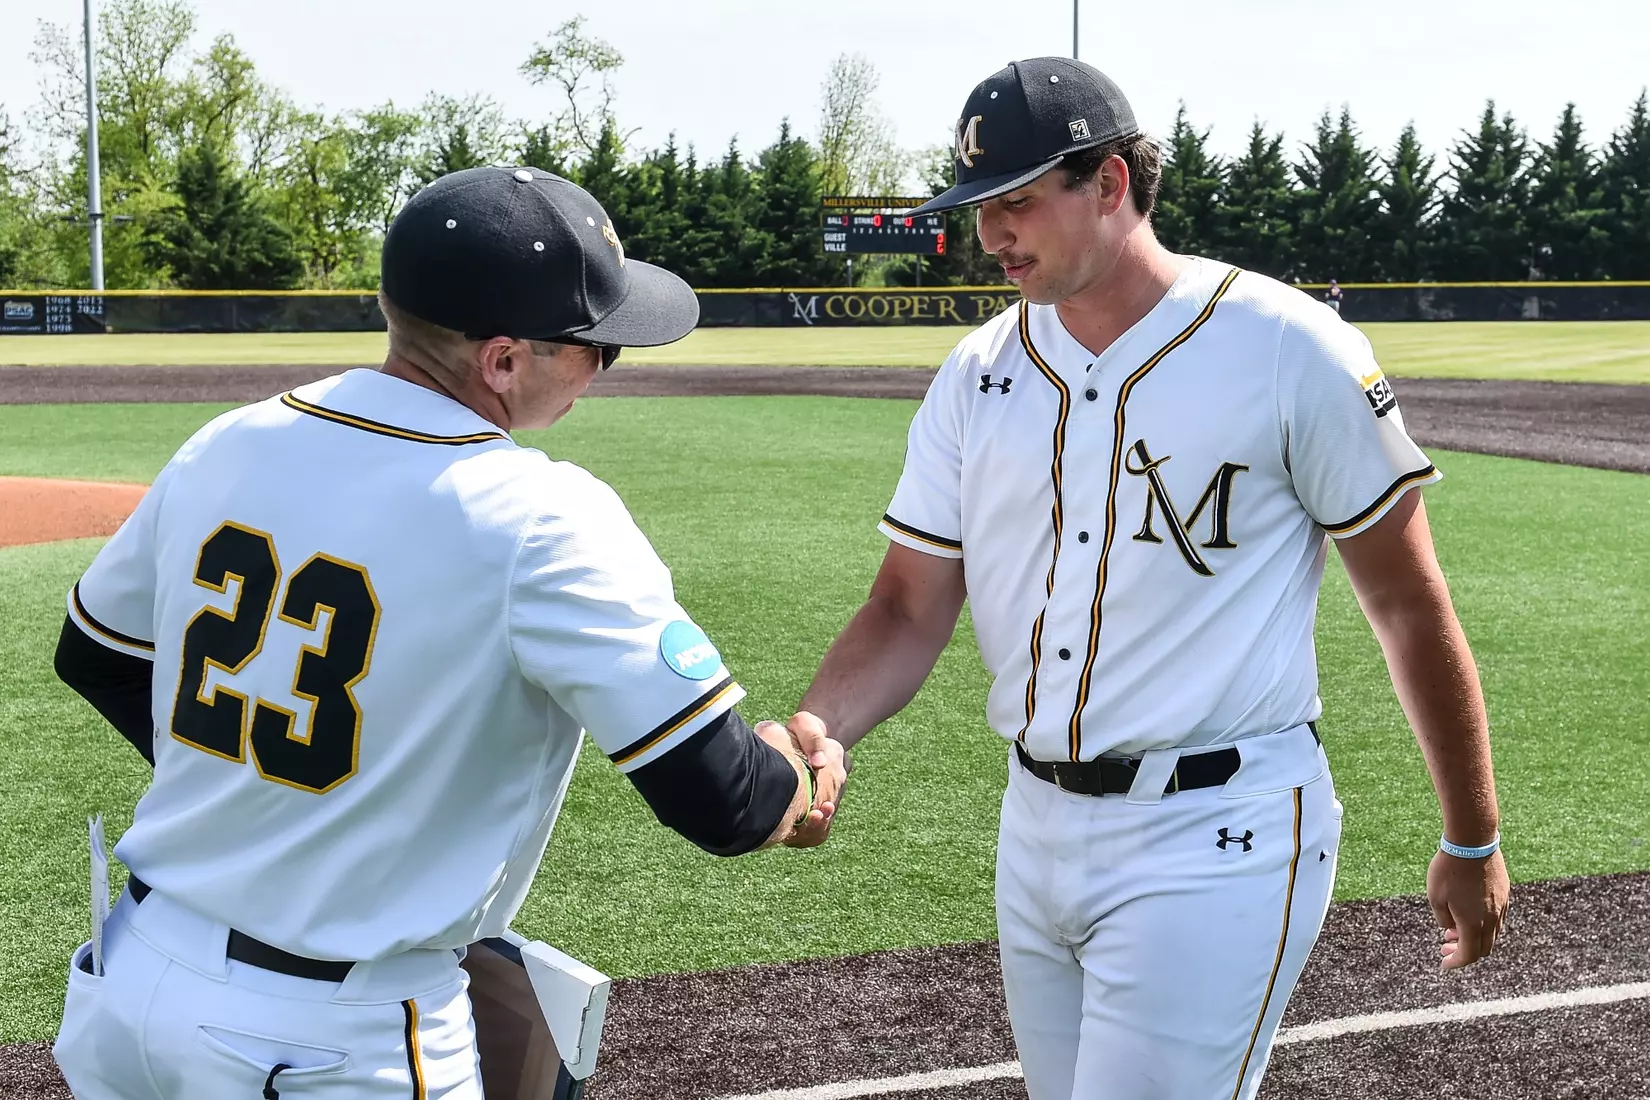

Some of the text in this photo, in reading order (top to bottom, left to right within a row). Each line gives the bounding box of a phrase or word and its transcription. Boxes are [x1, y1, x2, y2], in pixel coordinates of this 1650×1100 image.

[823, 198, 929, 207] MILLERSVILLE UNIVER
[824, 233, 846, 242] GUEST
[824, 243, 846, 252] VILLE
[825, 295, 967, 323] COOPER
[1125, 438, 1250, 577] M
[169, 519, 383, 795] 23
